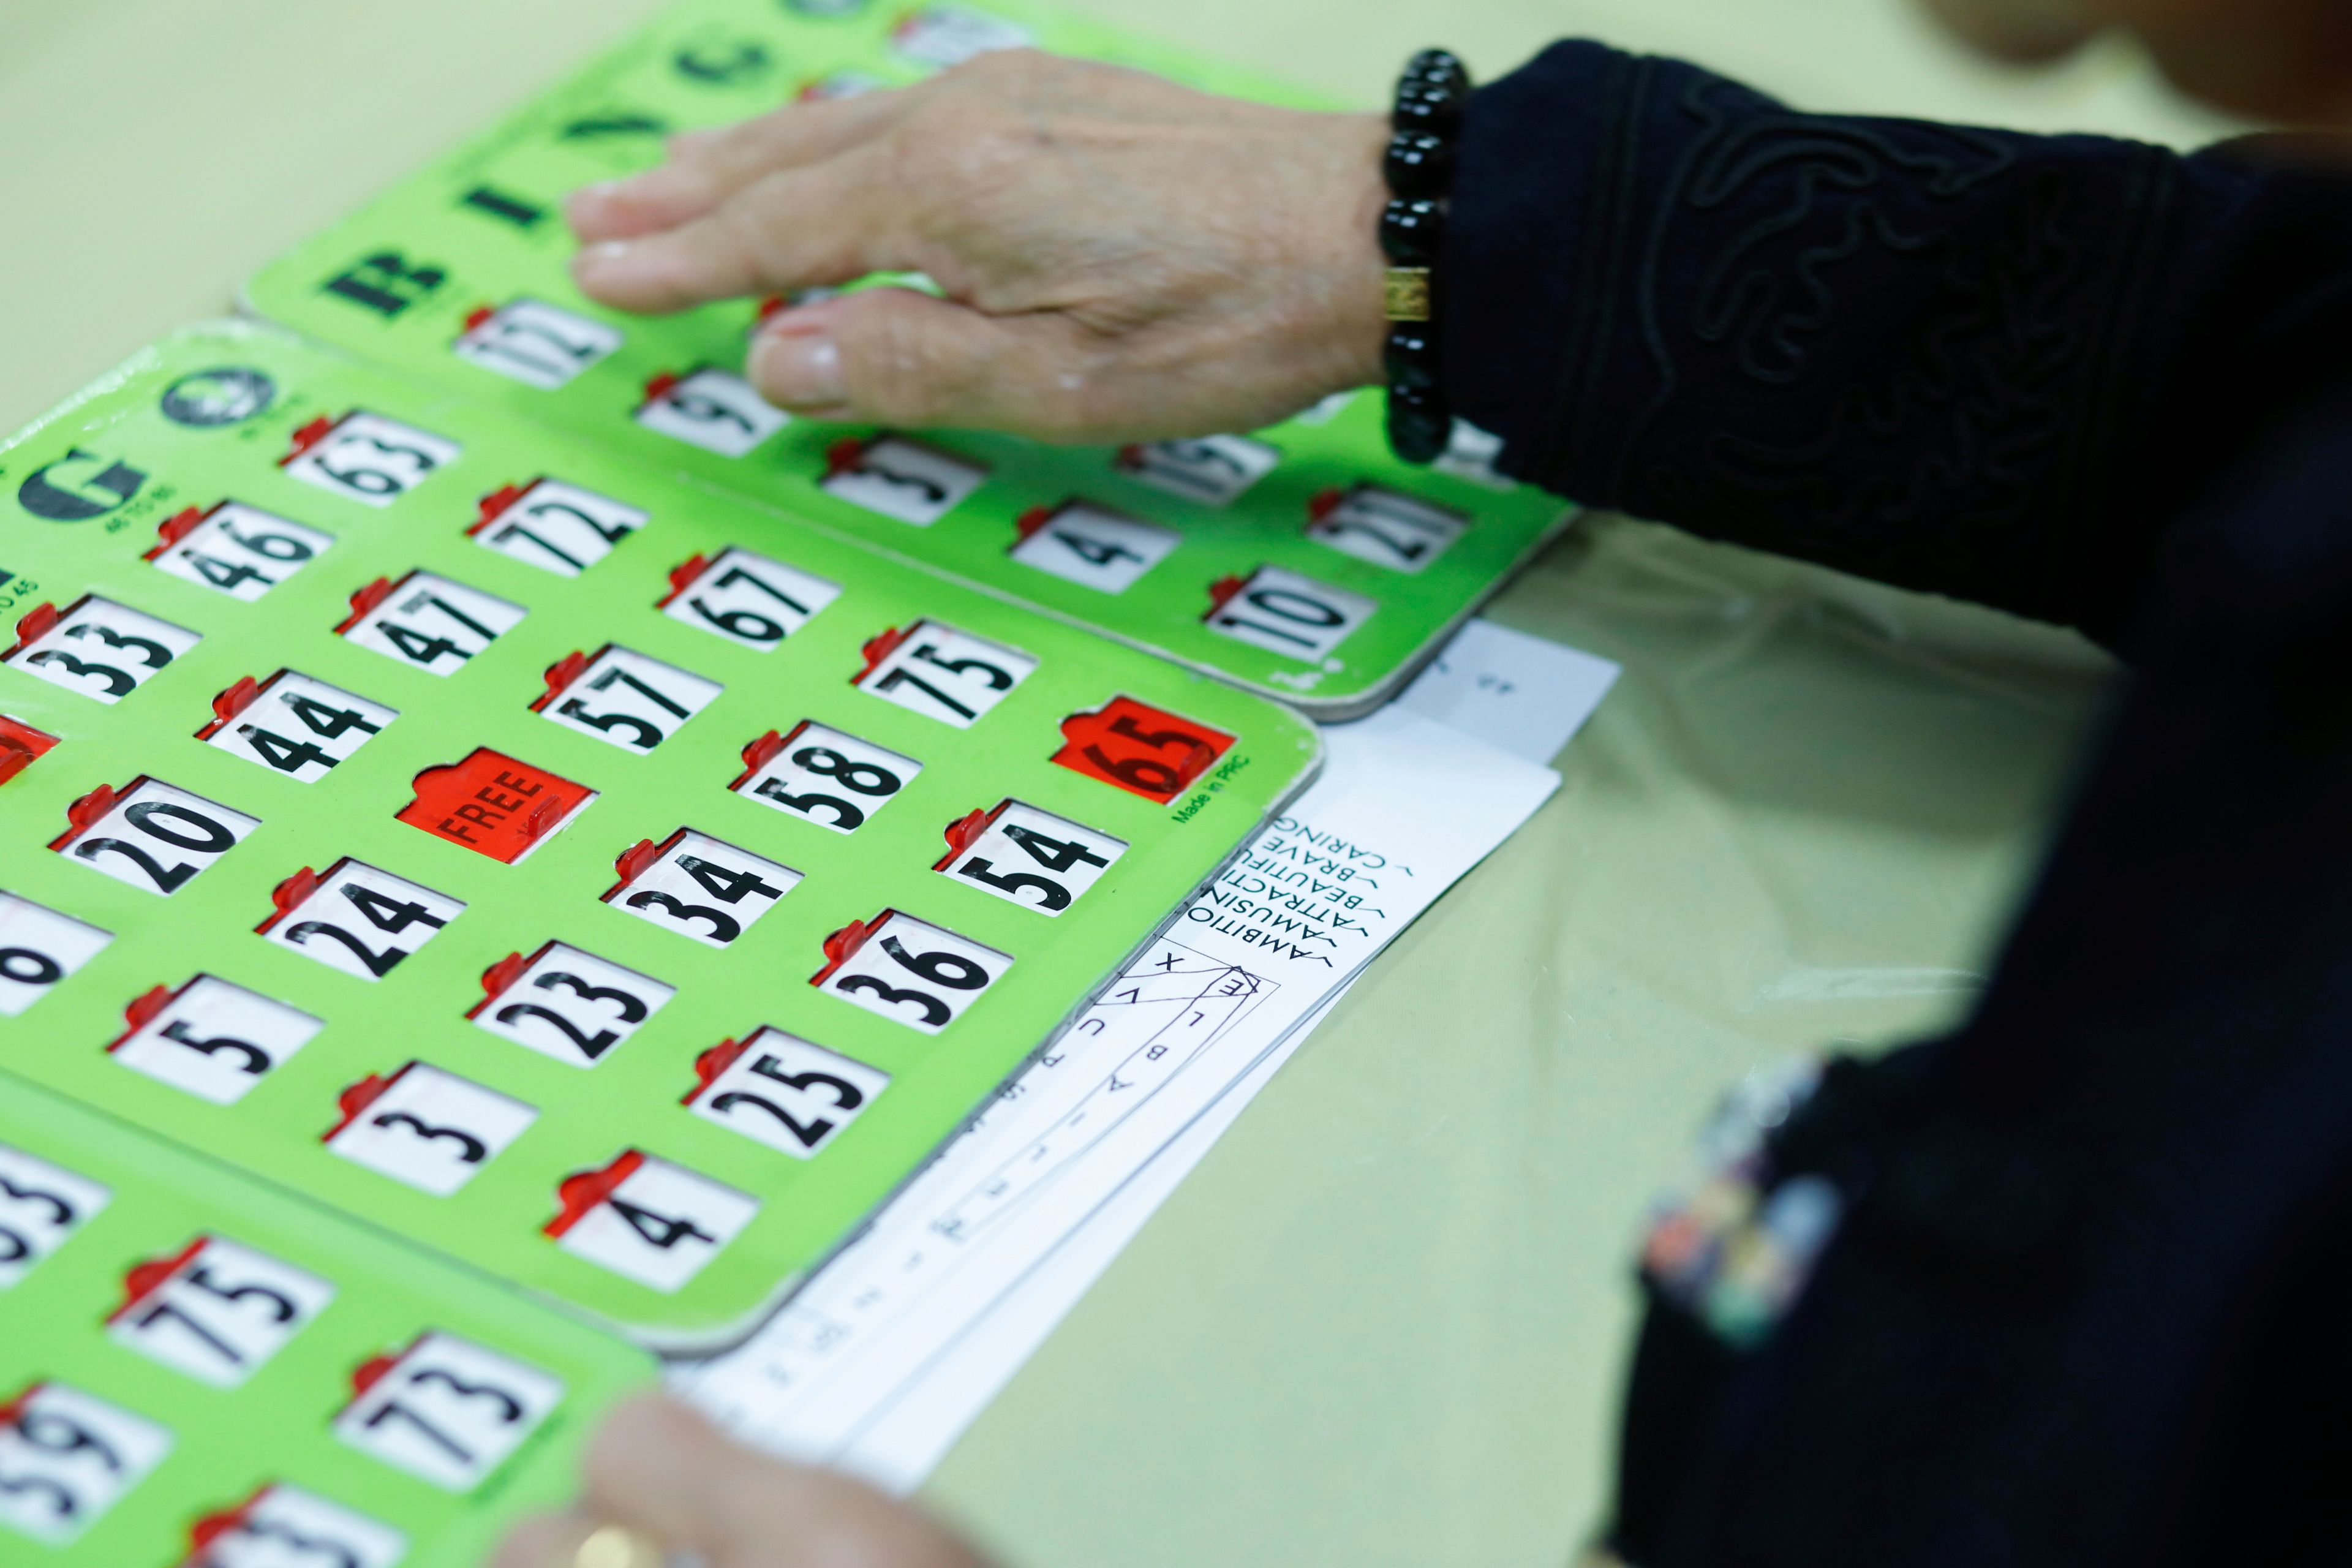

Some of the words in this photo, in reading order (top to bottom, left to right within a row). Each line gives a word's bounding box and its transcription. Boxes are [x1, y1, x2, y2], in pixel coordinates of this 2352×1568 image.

[325, 250, 445, 317] B
[477, 323, 592, 375] 12
[670, 393, 754, 433] 9
[18, 447, 148, 522] G
[314, 434, 436, 495] 63
[181, 521, 314, 589] 46
[492, 503, 633, 570] 72
[1049, 530, 1145, 567] 4
[375, 590, 498, 665] 47
[689, 567, 810, 641] 67
[1221, 590, 1348, 649] 10
[26, 624, 174, 697] 33
[875, 645, 1014, 720] 75
[237, 691, 382, 772] 44
[555, 666, 690, 748] 57
[753, 747, 902, 830] 58
[1082, 716, 1215, 794] 65
[1171, 794, 1211, 823] Made
[1215, 754, 1250, 782] PRC
[436, 771, 543, 843] FREE
[74, 801, 236, 895] 20
[959, 824, 1109, 911] 54
[1262, 837, 1356, 882] BRAVE
[1273, 817, 1385, 869] CARING
[285, 882, 448, 978] 24
[626, 854, 784, 943] 34
[1221, 869, 1355, 927] ATTRACTI
[1155, 952, 1185, 971] X
[1188, 907, 1313, 960] AMBITIO
[837, 936, 989, 1026] 36
[1115, 987, 1140, 1004] V
[1219, 979, 1244, 996] E
[159, 1020, 271, 1075] 5
[496, 971, 647, 1059] 23
[1079, 1018, 1105, 1036] U
[1188, 1011, 1205, 1027] L
[1042, 1054, 1066, 1067] P
[1110, 1074, 1134, 1092] A
[1147, 1044, 1168, 1061] B
[711, 1055, 863, 1147] 25
[372, 1112, 487, 1163] 3
[0, 1175, 74, 1264] 3
[606, 1196, 717, 1248] 4
[138, 1265, 297, 1365] 75
[363, 1366, 522, 1465] 73
